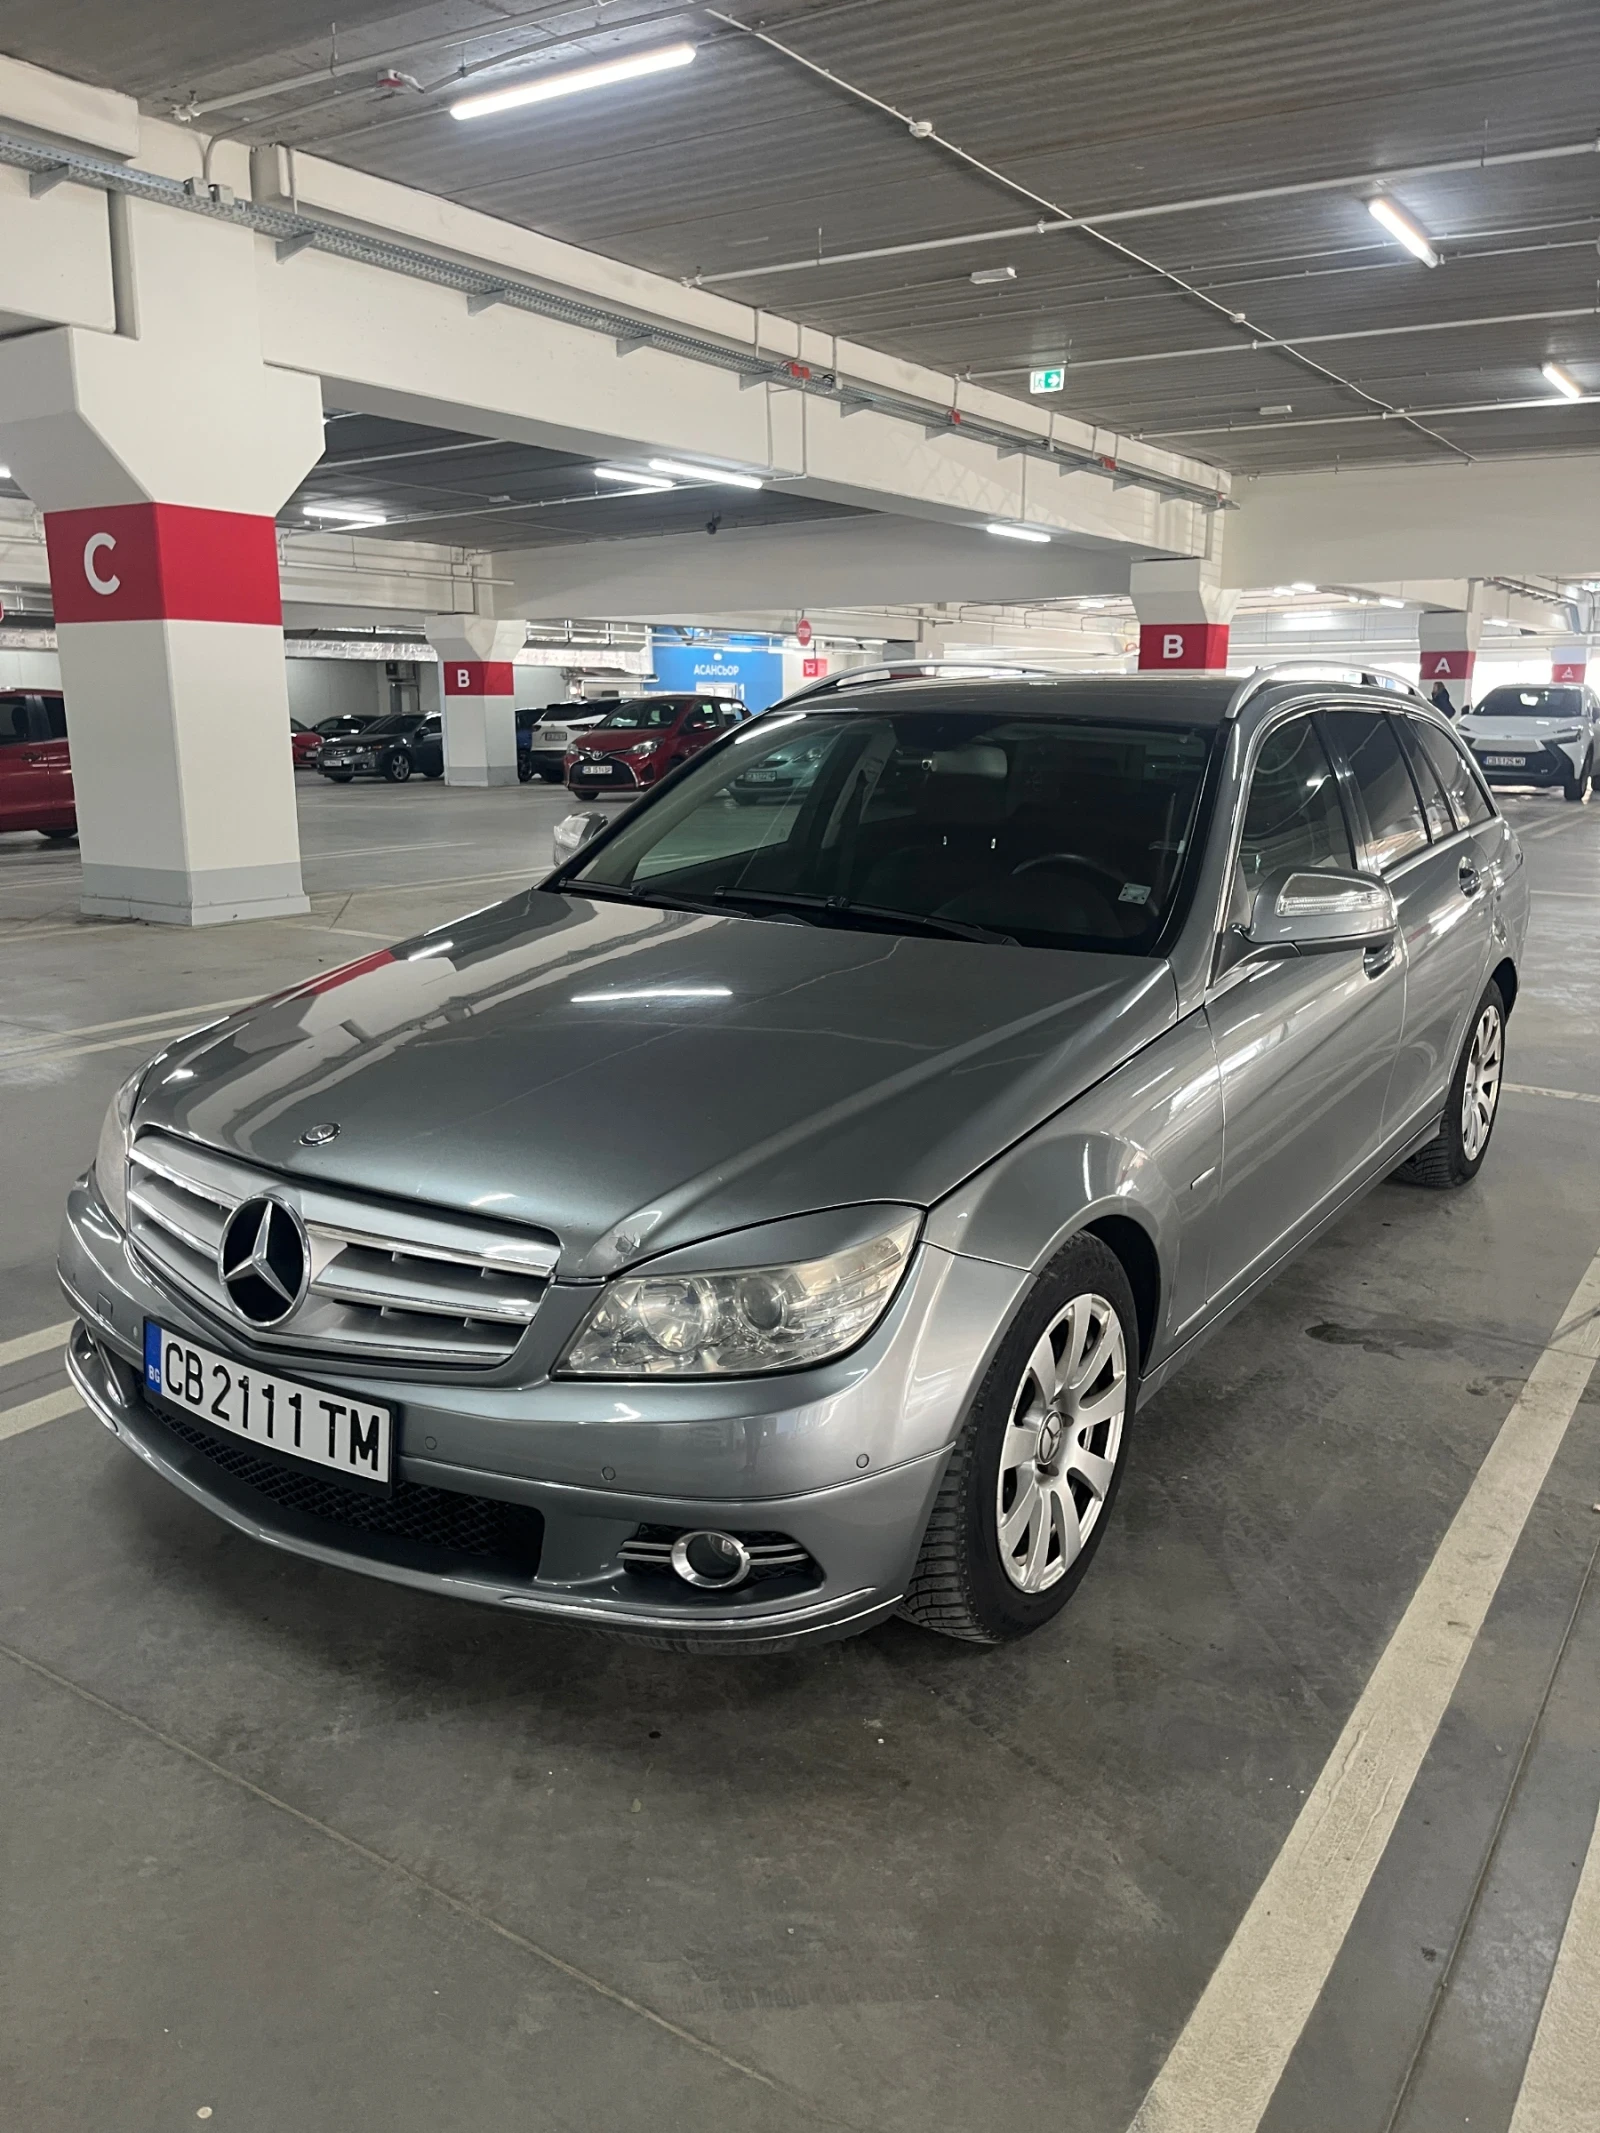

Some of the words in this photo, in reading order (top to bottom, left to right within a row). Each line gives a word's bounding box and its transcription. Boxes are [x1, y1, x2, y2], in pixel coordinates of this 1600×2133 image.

[83, 532, 121, 595] C
[1163, 634, 1184, 659] B
[693, 664, 740, 676] АСАНСЬОР
[1434, 657, 1451, 674] A
[1561, 666, 1574, 679] A
[457, 669, 470, 688] B
[739, 683, 745, 700] 1
[148, 1364, 161, 1384] BG
